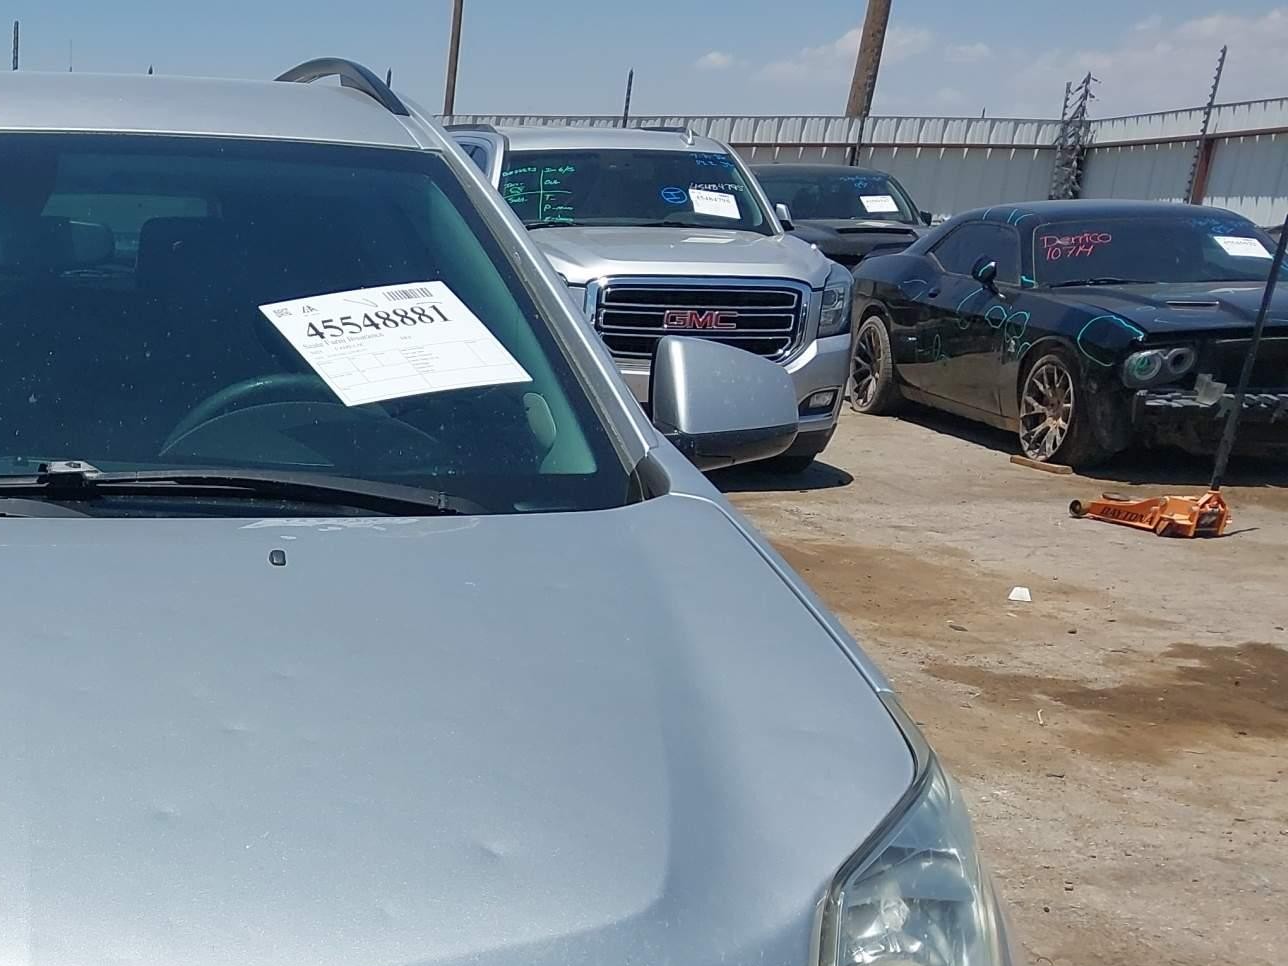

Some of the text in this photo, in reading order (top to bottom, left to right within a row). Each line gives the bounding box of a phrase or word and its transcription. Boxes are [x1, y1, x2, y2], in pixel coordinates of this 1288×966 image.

[306, 303, 453, 340] 45548881
[664, 310, 738, 329] GMC
[1100, 506, 1154, 526] DAYTONA
